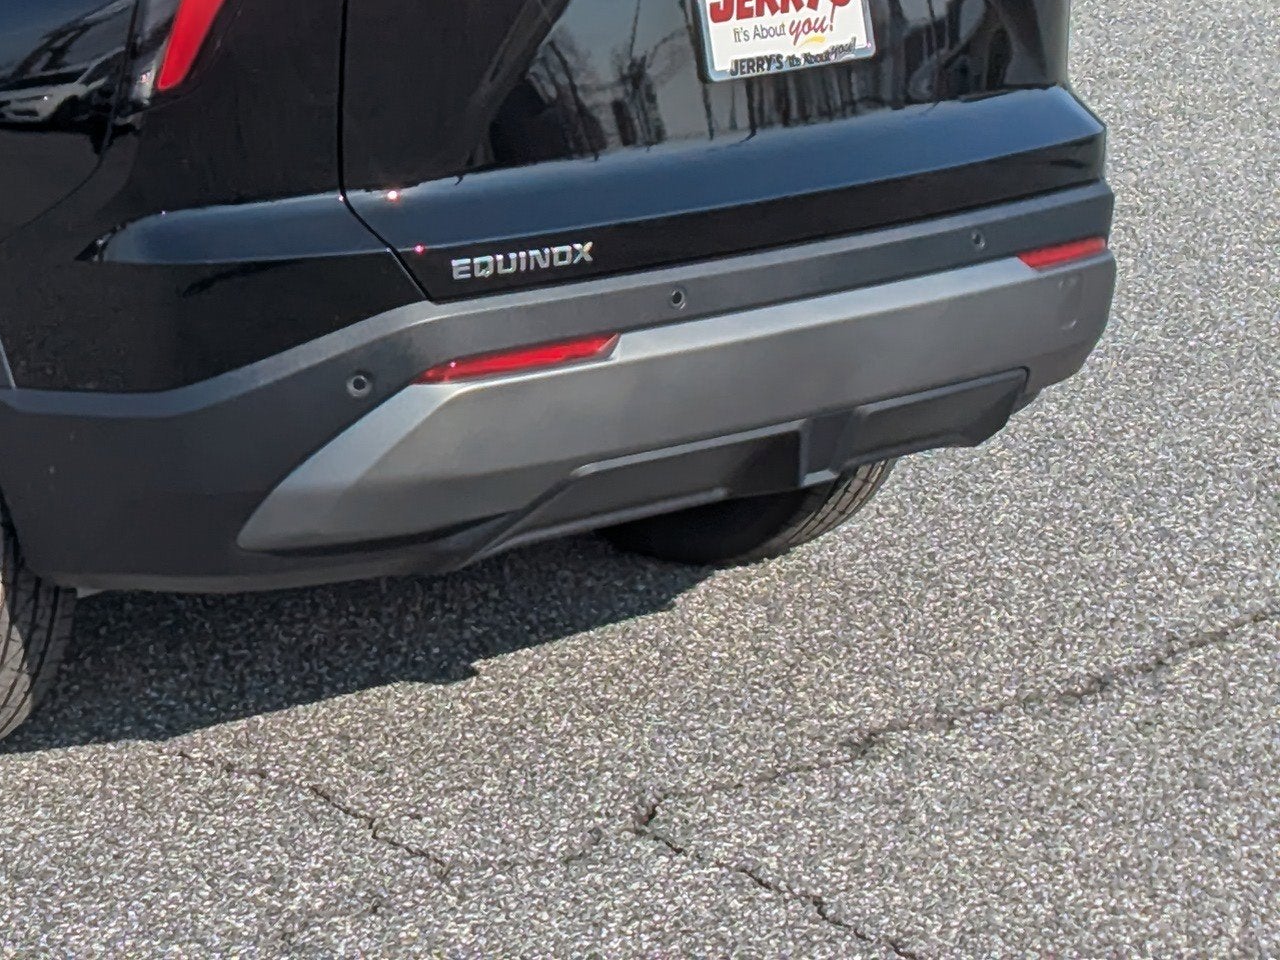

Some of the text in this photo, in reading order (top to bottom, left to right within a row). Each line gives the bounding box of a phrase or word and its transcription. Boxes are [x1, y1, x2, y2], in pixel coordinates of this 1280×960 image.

[733, 5, 835, 46] It's About you!
[730, 53, 784, 77] JERRY'S
[451, 241, 594, 280] EQUINOX
